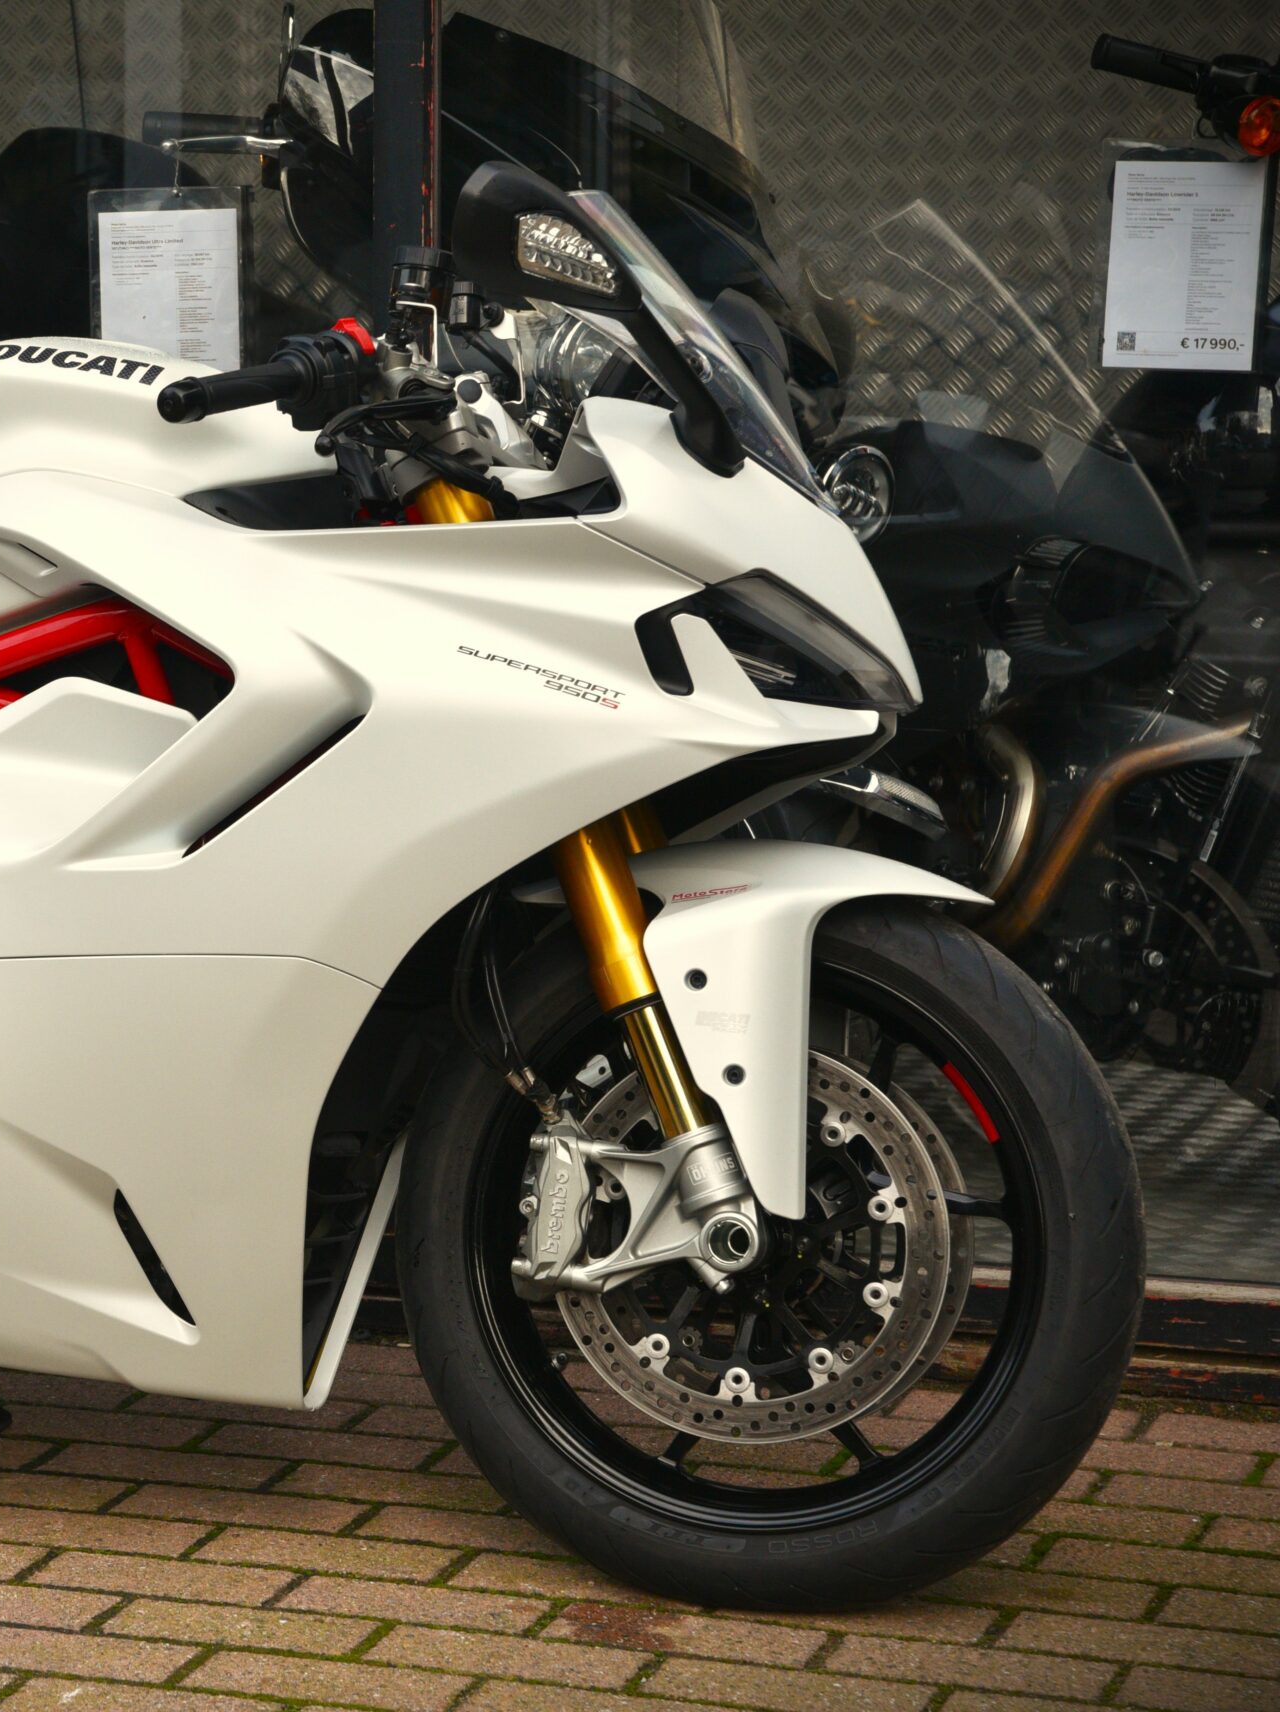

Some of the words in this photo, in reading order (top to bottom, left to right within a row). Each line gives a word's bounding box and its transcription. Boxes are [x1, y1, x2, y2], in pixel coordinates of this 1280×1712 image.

[1180, 337, 1190, 349] €
[457, 645, 626, 698] SUPERSPORT
[543, 679, 621, 709] 950S
[540, 1168, 570, 1255] brembo
[767, 1519, 879, 1554] ROSSO
